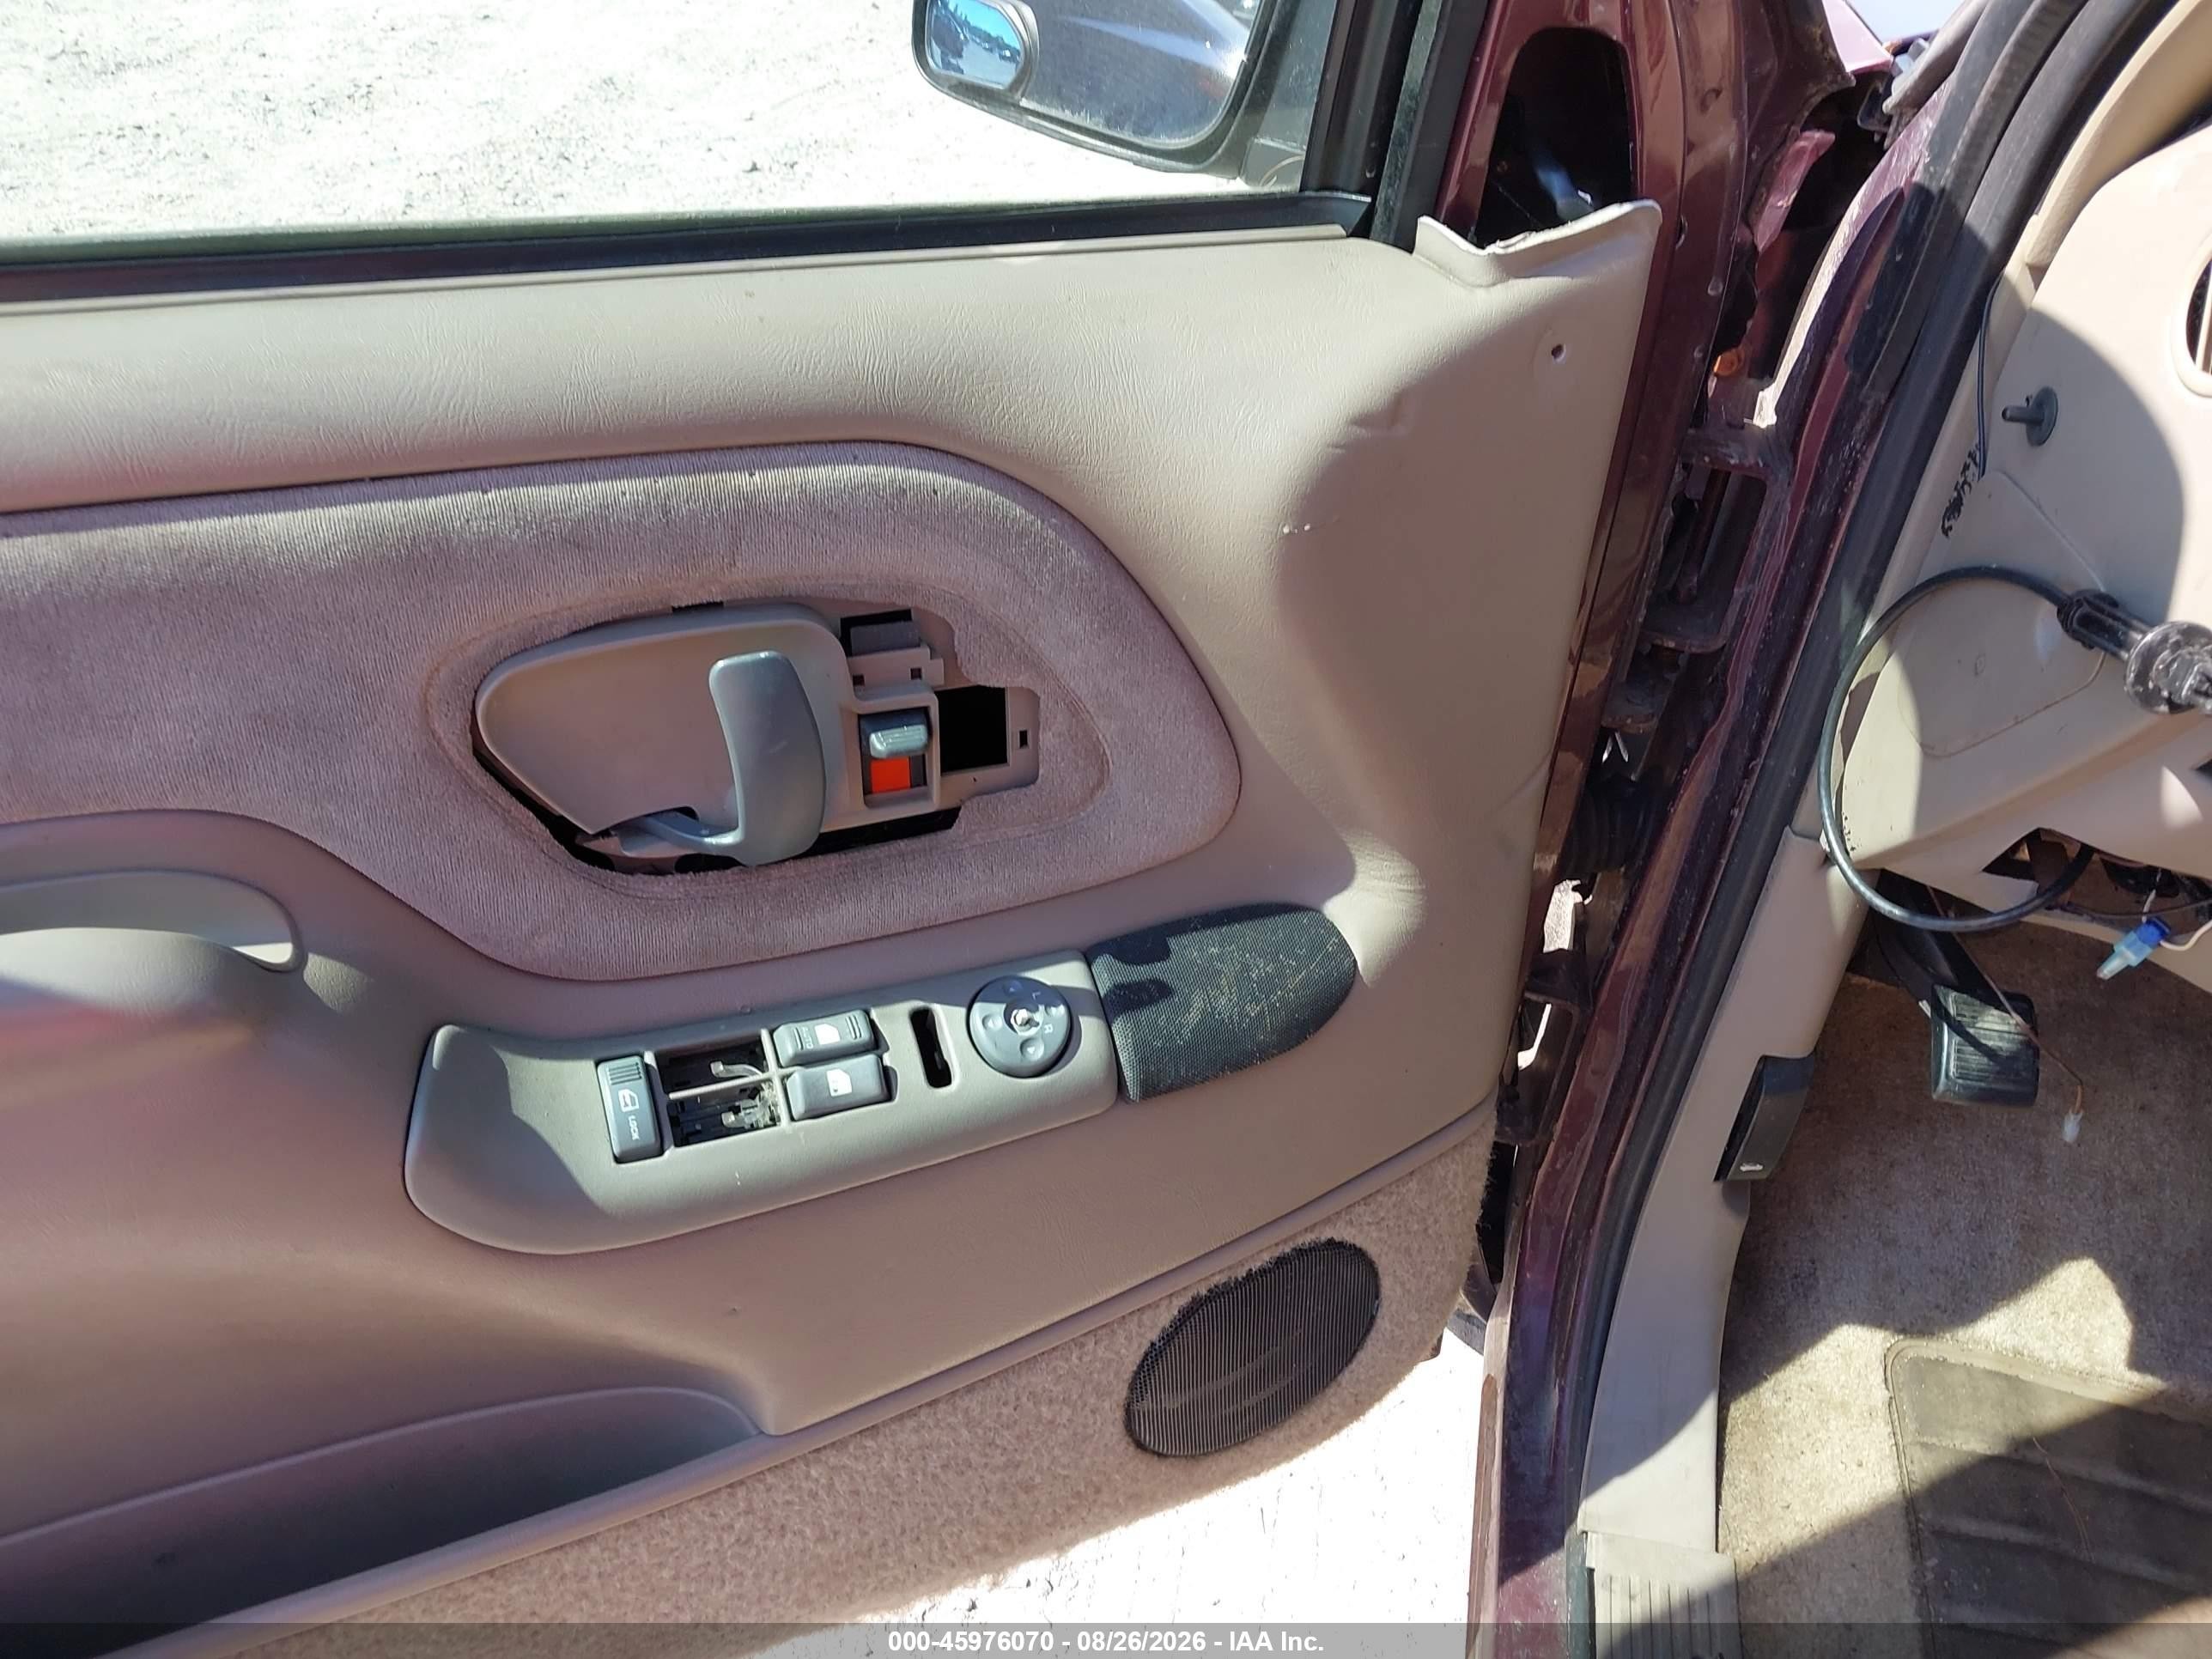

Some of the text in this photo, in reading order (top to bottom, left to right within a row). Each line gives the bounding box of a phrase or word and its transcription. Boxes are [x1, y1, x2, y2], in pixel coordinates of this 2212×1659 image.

[1031, 991, 1042, 1001] L
[1043, 1023, 1054, 1034] R
[628, 1115, 640, 1141] LOCK
